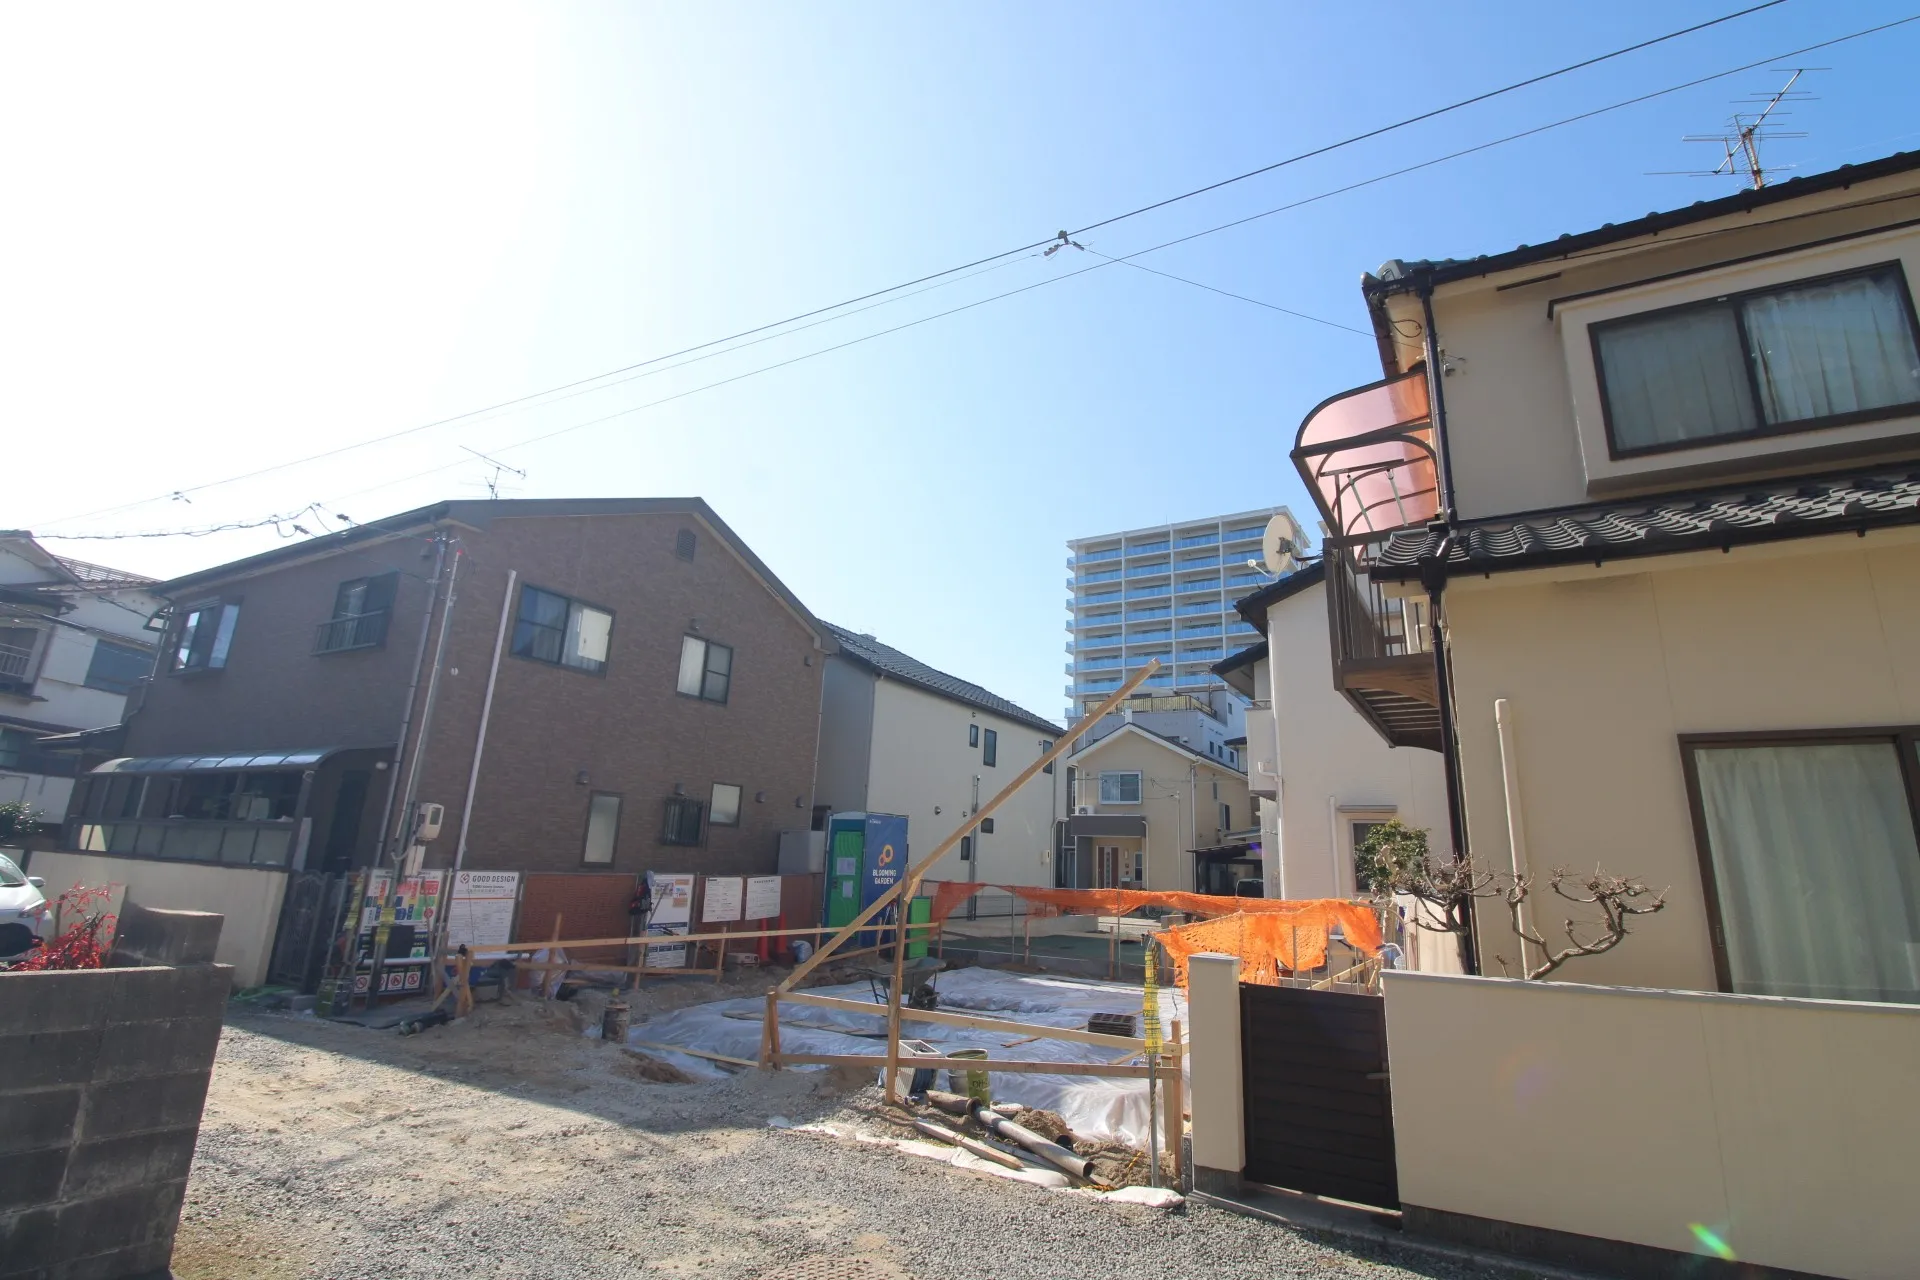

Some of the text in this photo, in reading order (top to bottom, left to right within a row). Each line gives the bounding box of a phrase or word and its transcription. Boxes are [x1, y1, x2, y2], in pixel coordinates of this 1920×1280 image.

[872, 869, 897, 877] BLOOMING
[472, 875, 516, 883] GOOD DESIGN
[874, 877, 894, 885] GARDEN
